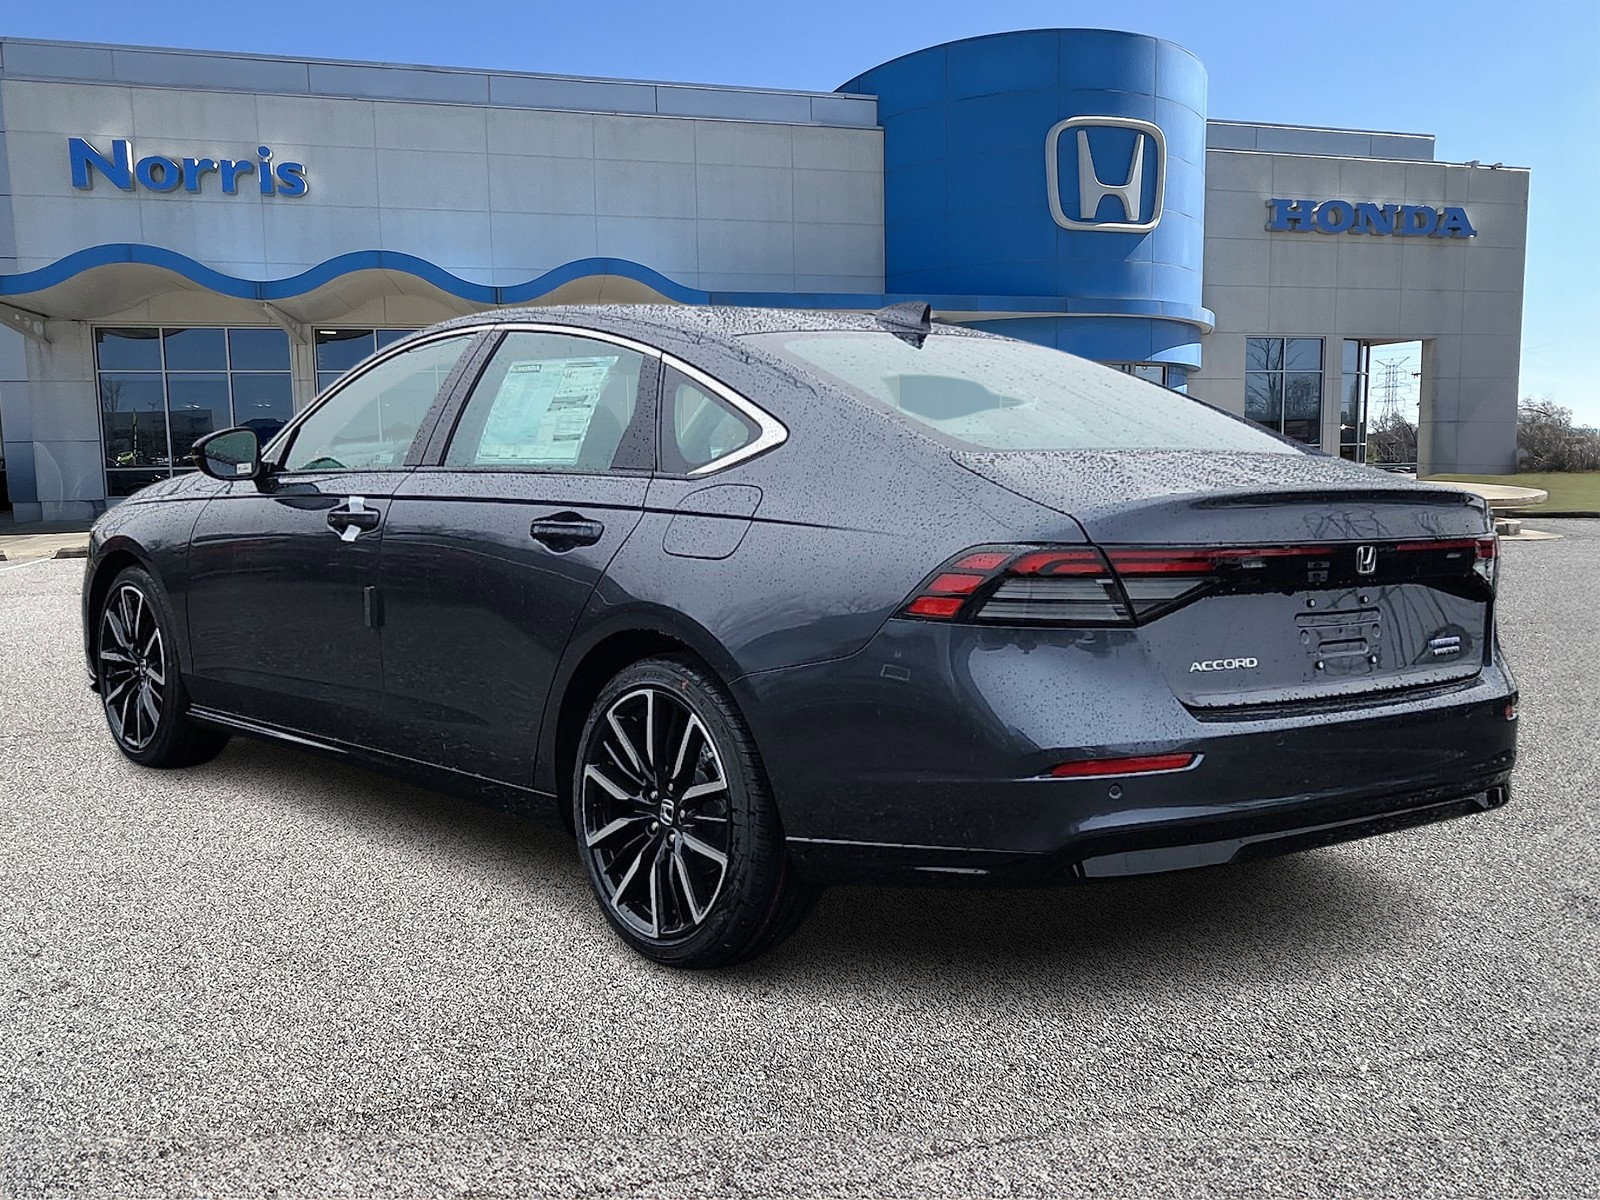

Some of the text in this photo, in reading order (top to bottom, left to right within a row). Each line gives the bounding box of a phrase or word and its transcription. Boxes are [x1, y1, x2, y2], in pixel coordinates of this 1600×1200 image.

[68, 137, 309, 197] Norris
[1265, 198, 1478, 239] HONDA
[1189, 657, 1258, 673] ACCORD
